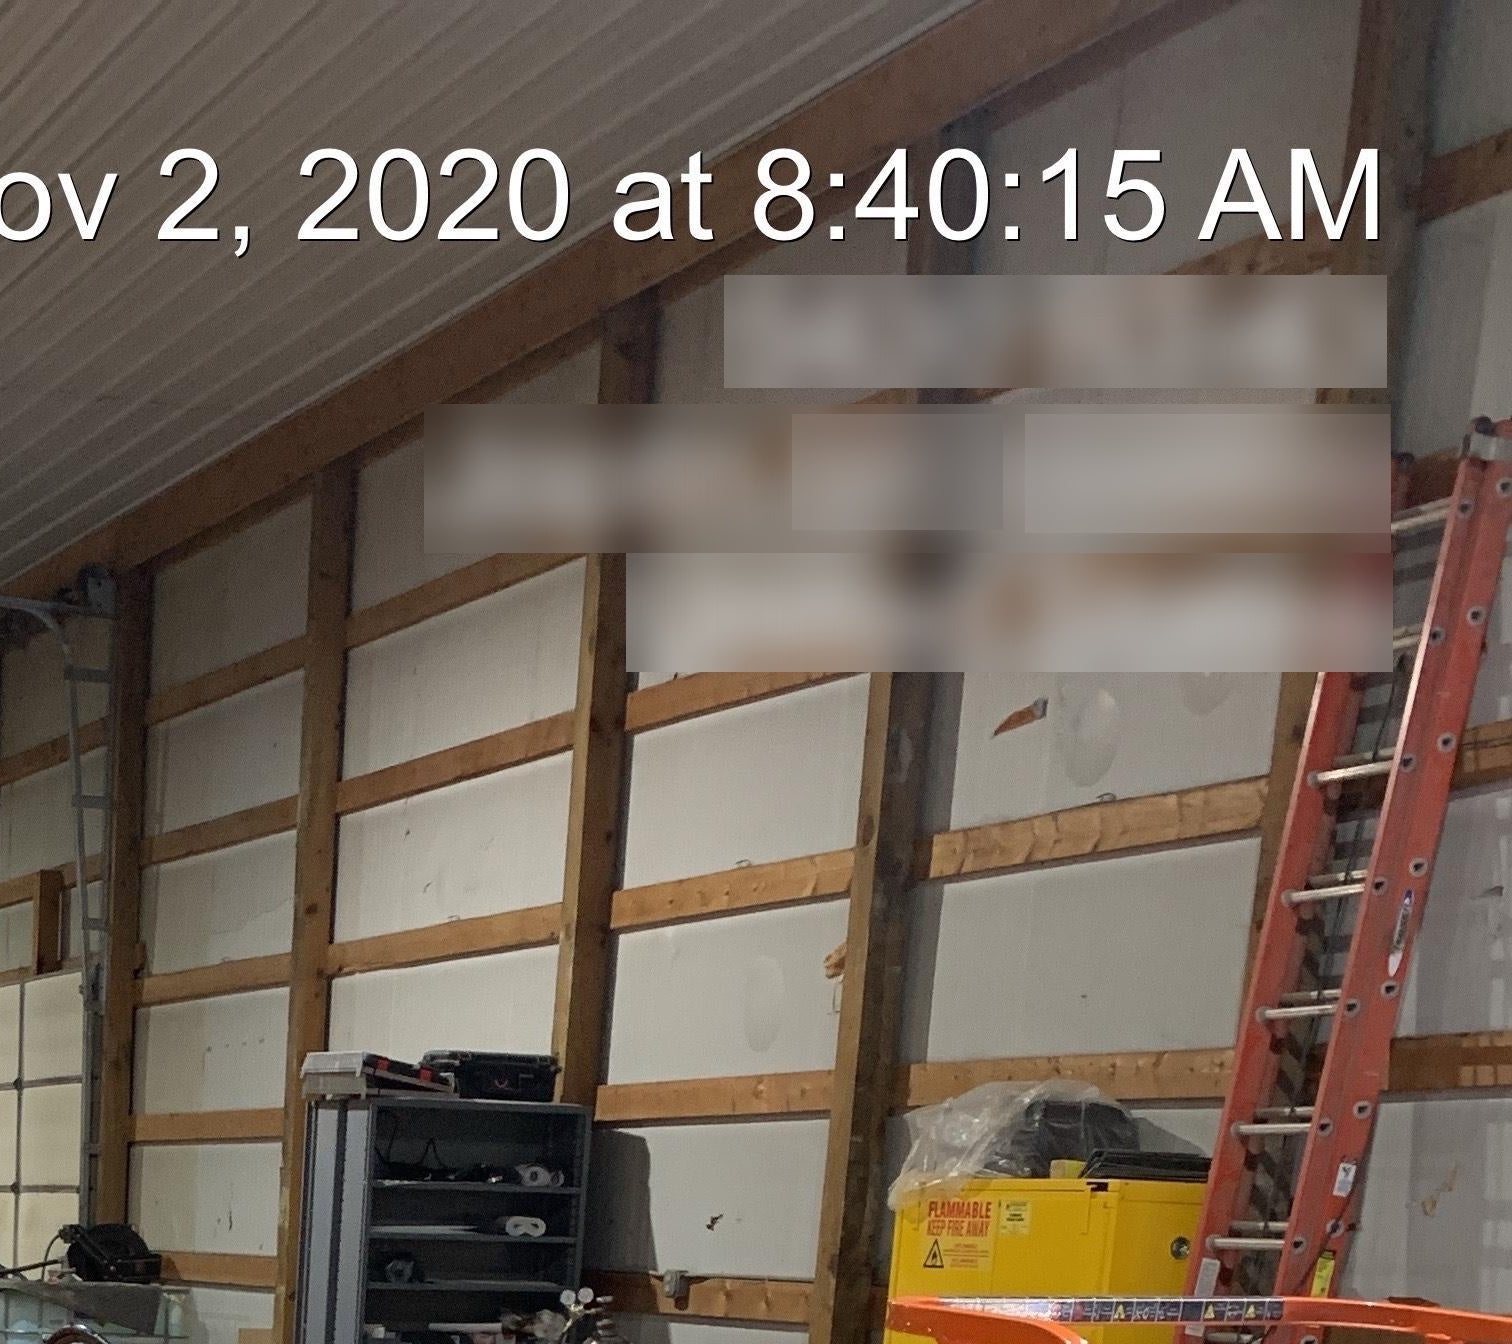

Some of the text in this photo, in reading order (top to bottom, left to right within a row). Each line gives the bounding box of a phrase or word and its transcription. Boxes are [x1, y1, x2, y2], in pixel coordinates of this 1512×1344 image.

[928, 1200, 992, 1219] FLAMMABLE
[926, 1220, 991, 1237] KEEP FIRE AWAY
